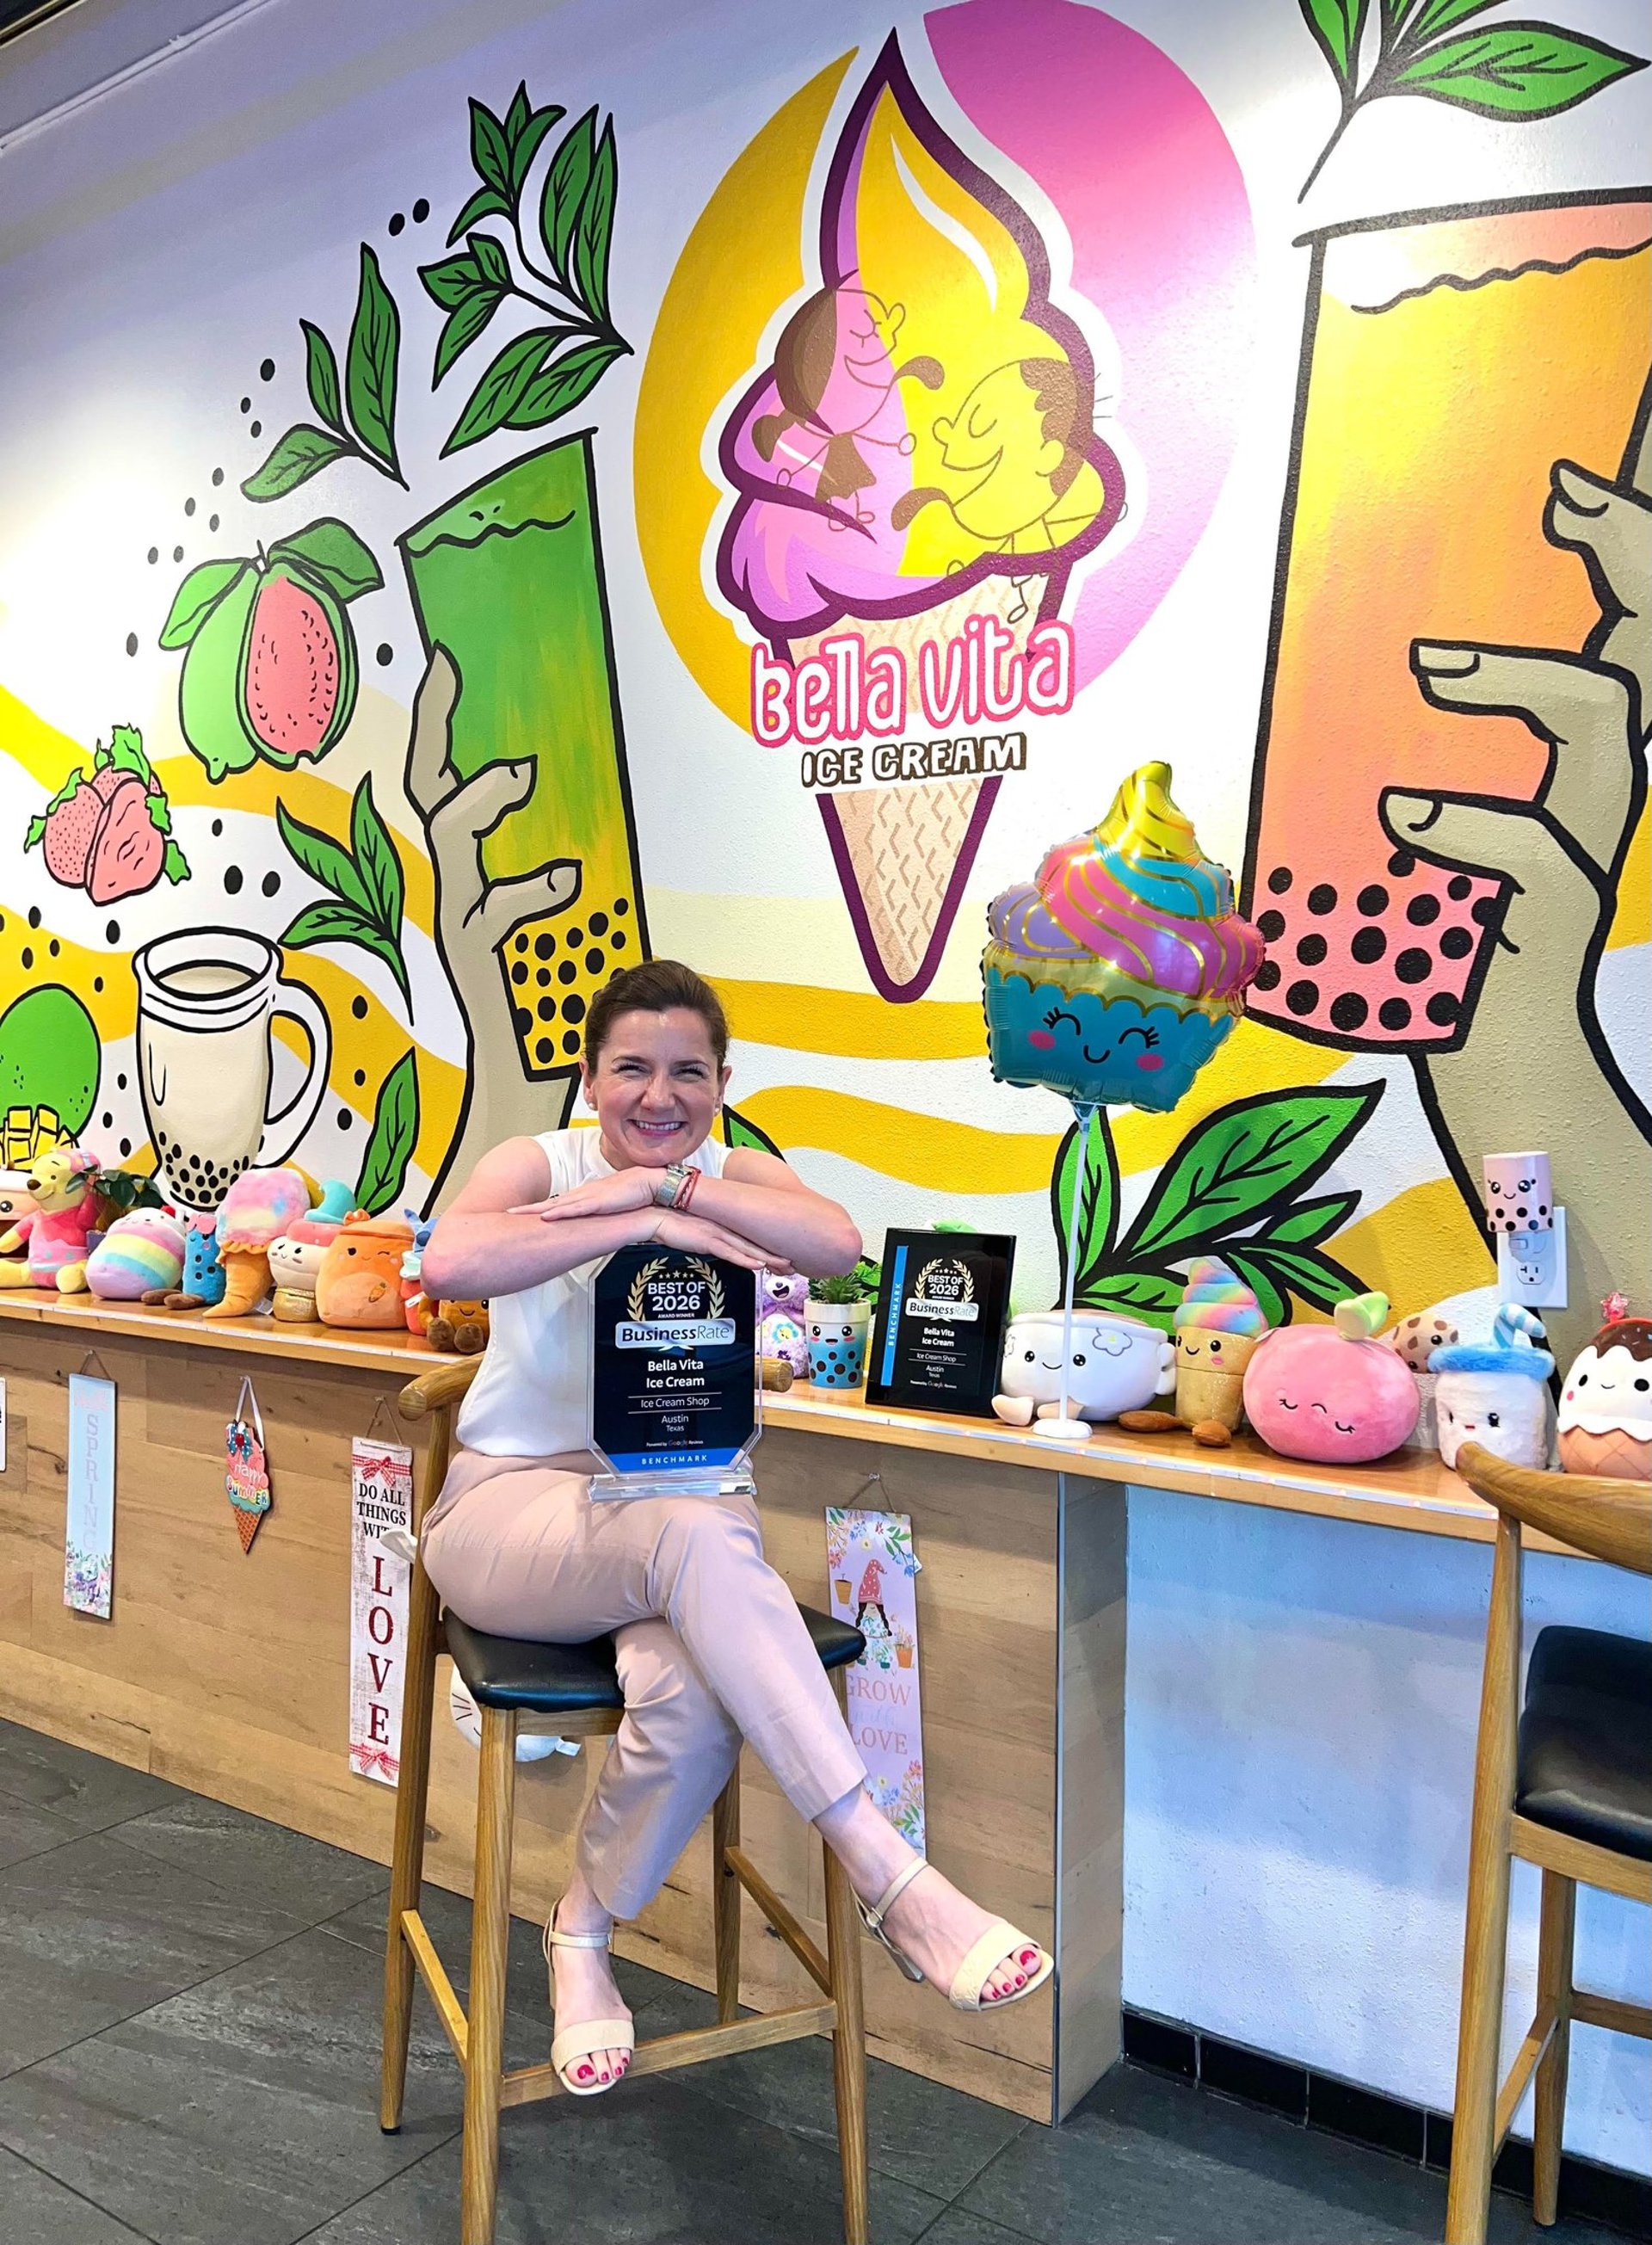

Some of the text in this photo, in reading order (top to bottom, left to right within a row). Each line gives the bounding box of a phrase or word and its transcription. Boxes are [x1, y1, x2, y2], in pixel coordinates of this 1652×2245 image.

[801, 732, 1027, 788] ICE CREAM
[928, 1274, 963, 1285] BEST OF
[648, 1281, 706, 1295] BEST OF
[929, 1284, 959, 1296] 2026
[652, 1296, 700, 1311] 2026
[888, 1283, 901, 1347] BENCHMARK
[909, 1303, 975, 1317] BusinessRate
[622, 1325, 730, 1341] BusinessRate
[924, 1327, 954, 1337] Bella Vita
[932, 1338, 954, 1348] Cream
[648, 1360, 704, 1372] Bella Vita
[926, 1365, 944, 1373] Austin
[646, 1377, 705, 1388] Ice Cream
[641, 1397, 710, 1409] Ice Cream Shop
[662, 1415, 689, 1423] Austin
[642, 1454, 707, 1465] BENCHMARK
[359, 1483, 405, 1506] DO ALL
[356, 1502, 406, 1526] THINGS
[367, 1555, 394, 1746] LOVE
